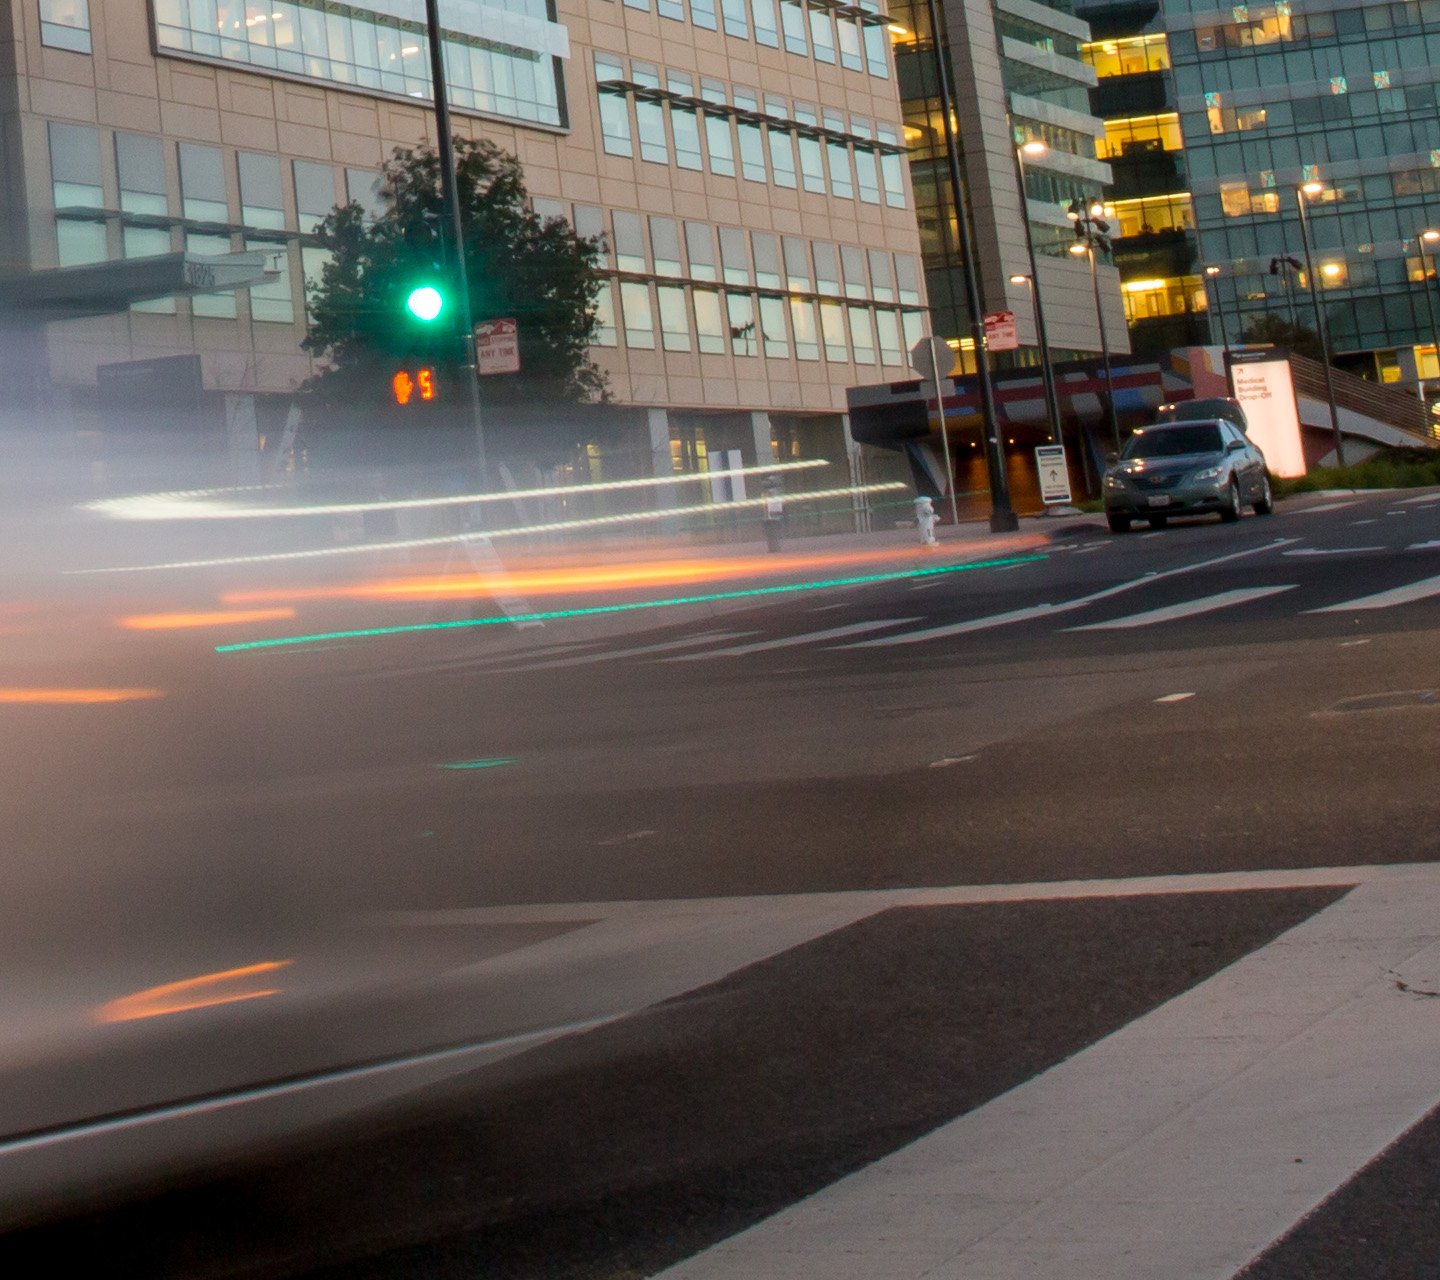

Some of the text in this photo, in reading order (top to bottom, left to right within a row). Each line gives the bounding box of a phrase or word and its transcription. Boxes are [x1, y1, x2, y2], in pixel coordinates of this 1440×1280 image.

[481, 349, 495, 358] ANY
[418, 369, 433, 400] 5
[1238, 385, 1267, 393] Building
